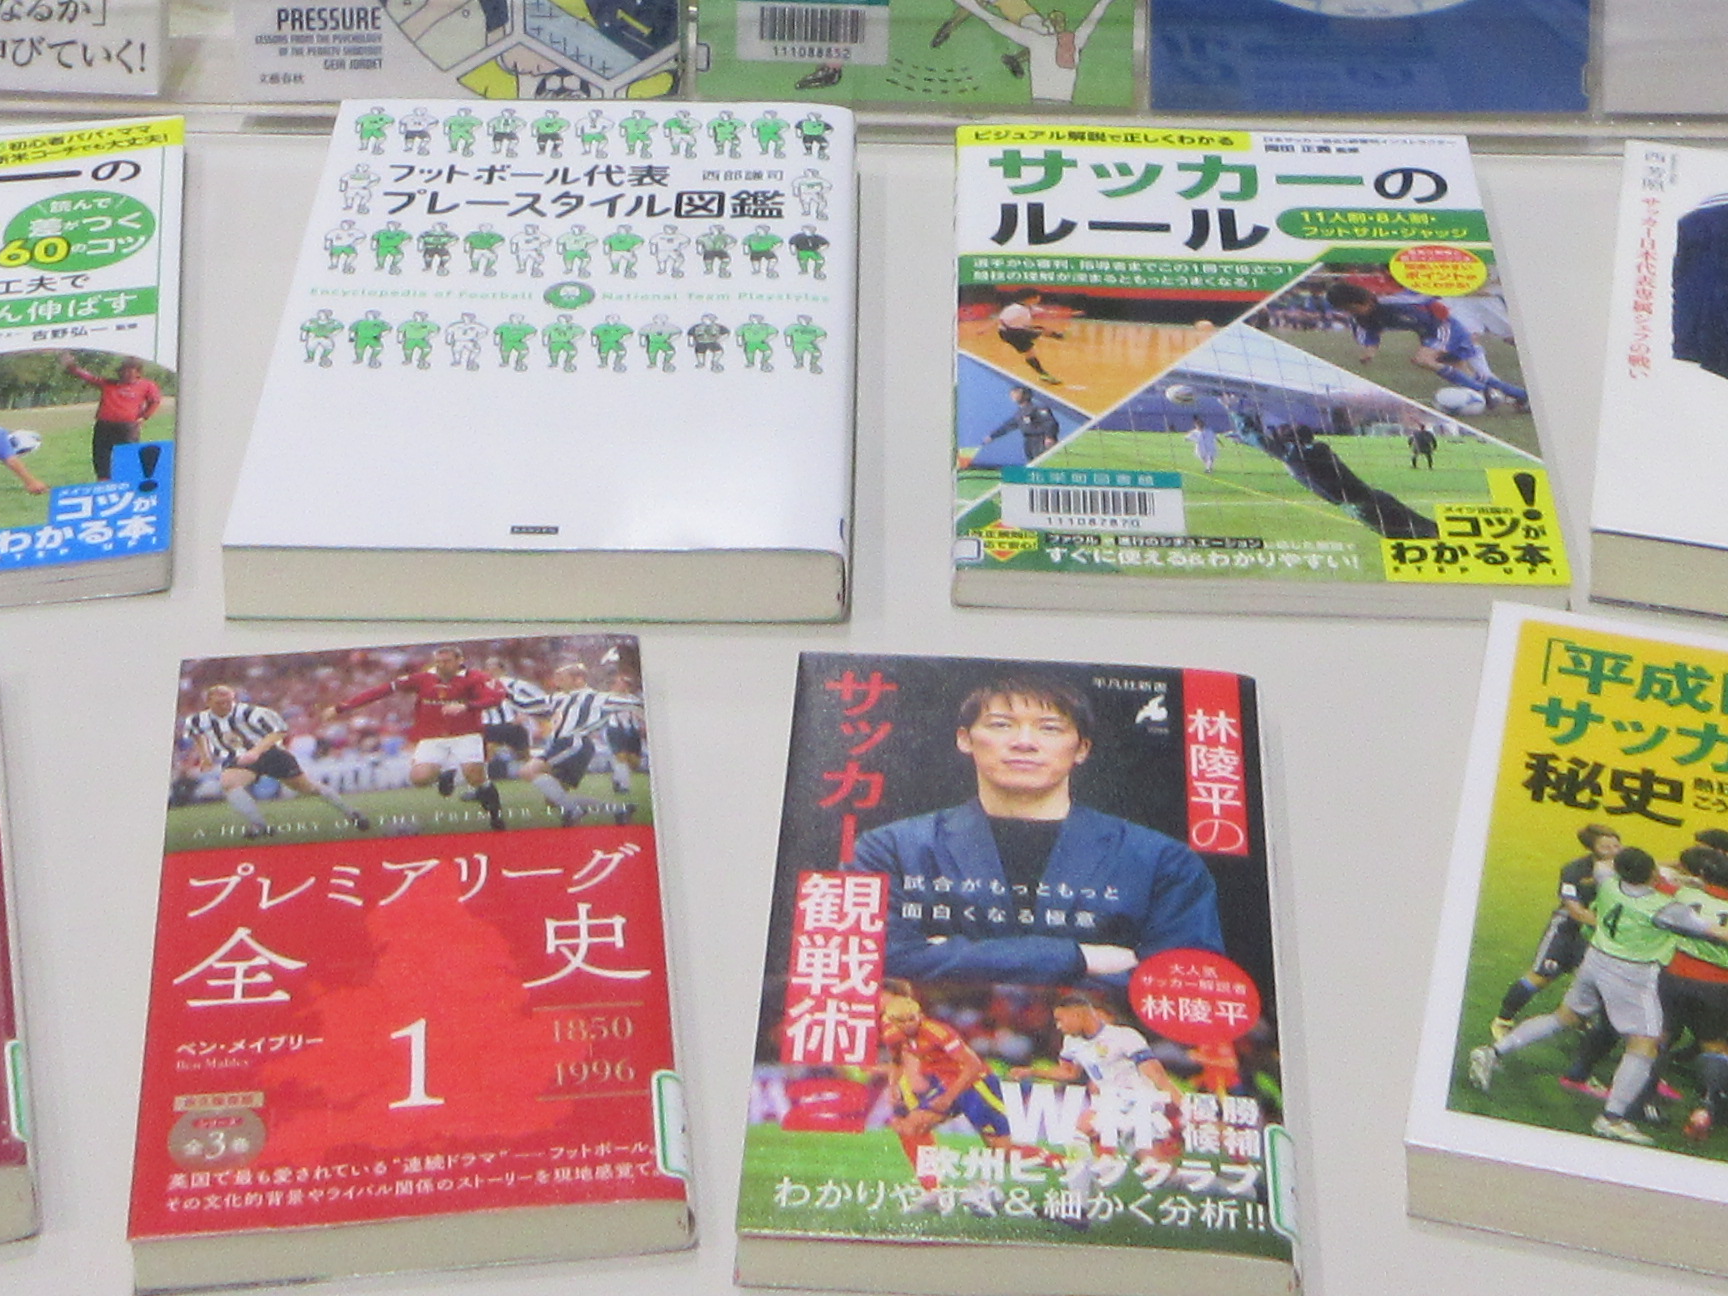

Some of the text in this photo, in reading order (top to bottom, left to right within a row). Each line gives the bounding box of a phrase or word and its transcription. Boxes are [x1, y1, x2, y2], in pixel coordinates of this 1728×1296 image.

[277, 7, 382, 31] PRESSURE
[973, 129, 1235, 147] ビジュアル解説で正しくわかる
[387, 163, 671, 187] フットボール代表
[987, 148, 1450, 203] サッカーの
[381, 189, 785, 220] プレースタイル図鑑
[28, 213, 143, 238] 差がつく
[990, 203, 1271, 252] ルール
[458, 288, 534, 301] Football
[55, 492, 158, 521] コツが
[1446, 513, 1547, 540] コツが
[1390, 542, 1553, 567] わかる本
[1091, 675, 1169, 693] 平凡社新書
[818, 669, 898, 864] サッカー
[1187, 708, 1247, 853] 林陵平の
[1522, 752, 1687, 828] 秘史
[186, 842, 640, 920] プレミアリーグ
[903, 874, 1120, 901] 試合がもっともっと
[900, 903, 1097, 928] 面白くなる極意
[786, 872, 884, 1065] 観戦術
[1169, 964, 1219, 979] 大人気
[1141, 994, 1250, 1026] 林陵平
[174, 1032, 324, 1056] ベン・メイブリー
[550, 1016, 635, 1045] 1850
[388, 1017, 446, 1110] 1
[550, 1058, 636, 1086] 1996
[1183, 1096, 1259, 1125] 優勝
